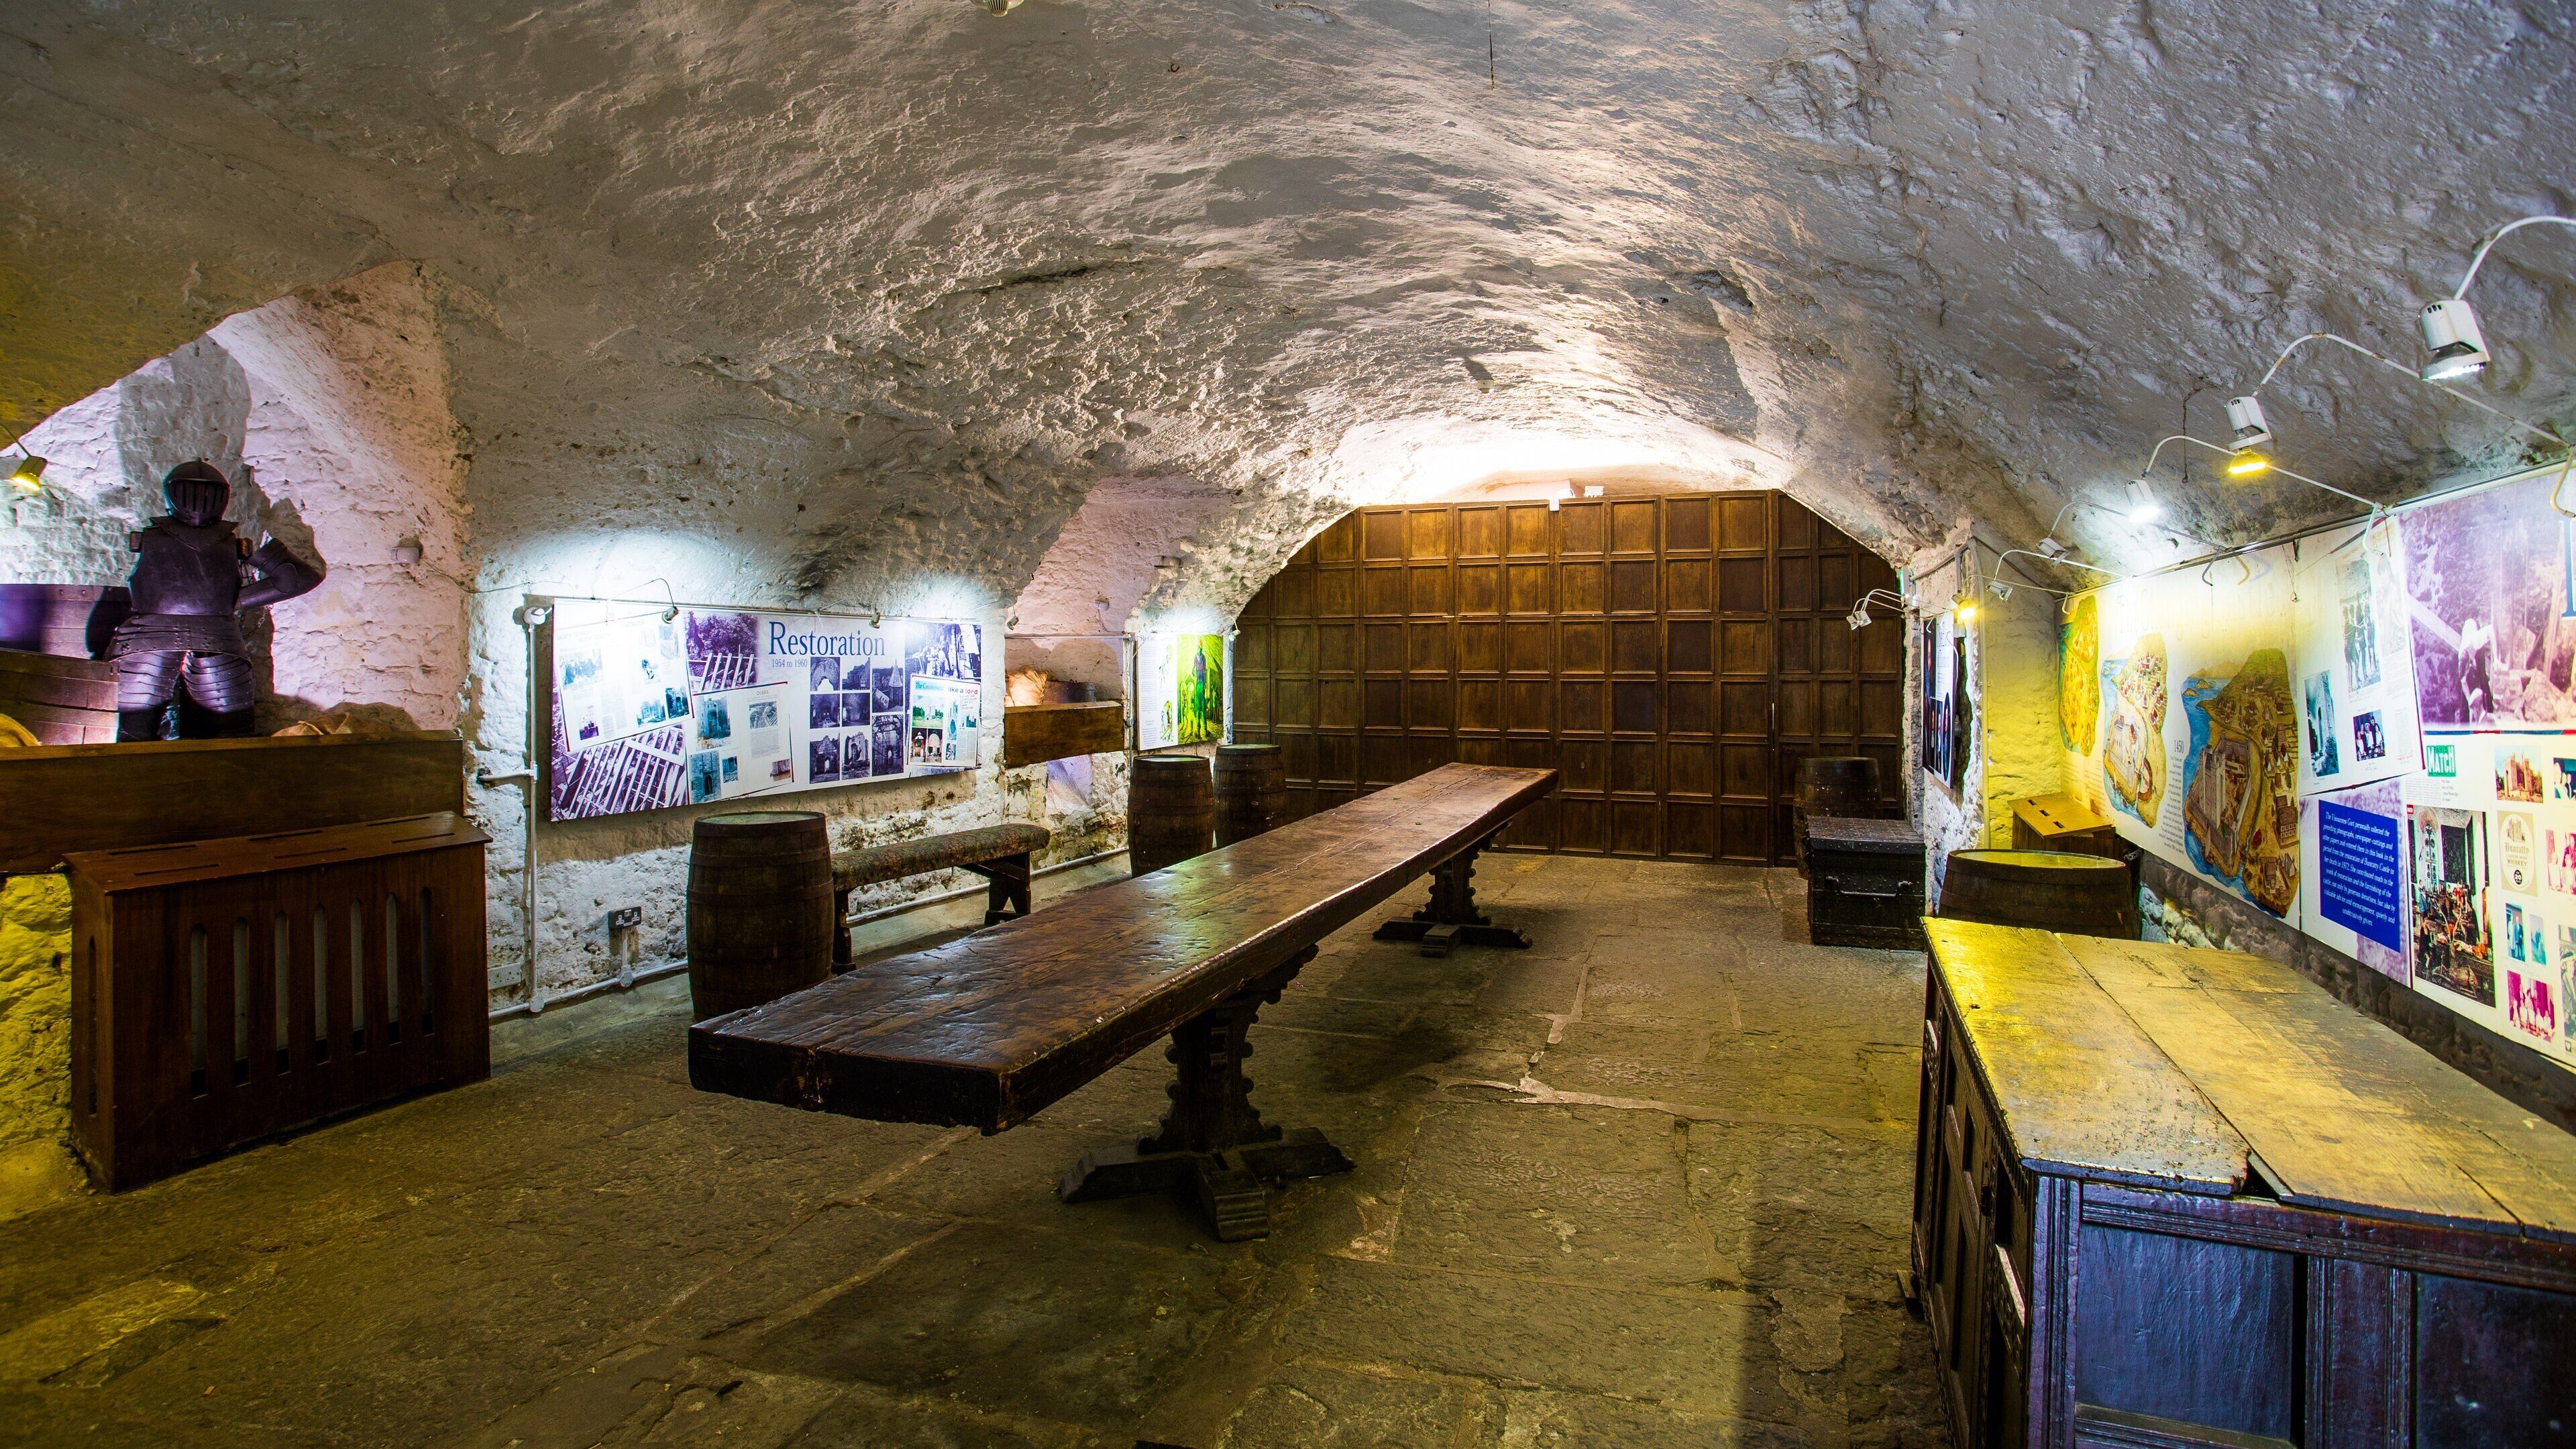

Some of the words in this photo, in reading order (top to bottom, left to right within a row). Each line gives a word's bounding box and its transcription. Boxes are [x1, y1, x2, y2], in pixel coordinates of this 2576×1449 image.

[769, 621, 885, 655] Restoration
[771, 659, 785, 667] 1954
[794, 659, 808, 667] 1960
[2174, 740, 2184, 753] 1450
[2427, 746, 2455, 773] MATCH
[2355, 822, 2370, 833] personally
[2357, 845, 2365, 853] them
[2507, 859, 2527, 867] WHISKEY
[2391, 904, 2396, 913] by
